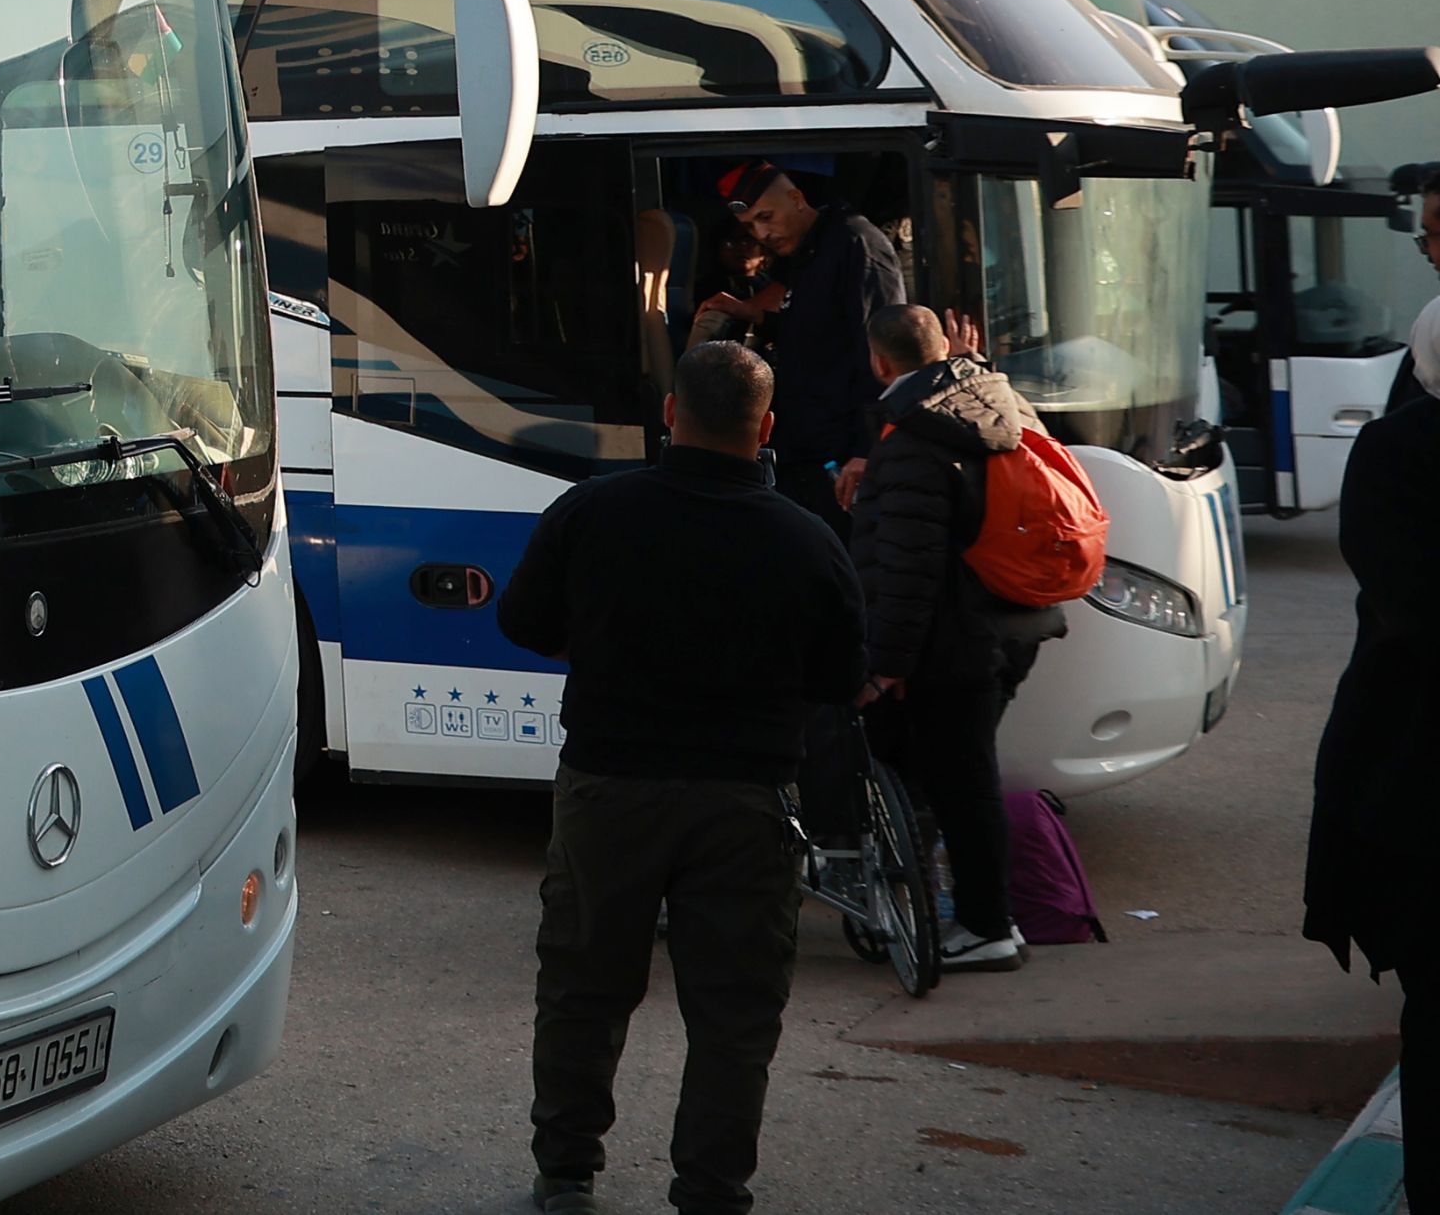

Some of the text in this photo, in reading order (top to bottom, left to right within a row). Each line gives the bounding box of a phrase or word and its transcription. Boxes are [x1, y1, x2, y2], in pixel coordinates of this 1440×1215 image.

[134, 142, 162, 164] 29
[272, 298, 316, 317] INER
[484, 715, 501, 725] TV
[445, 723, 469, 733] WC
